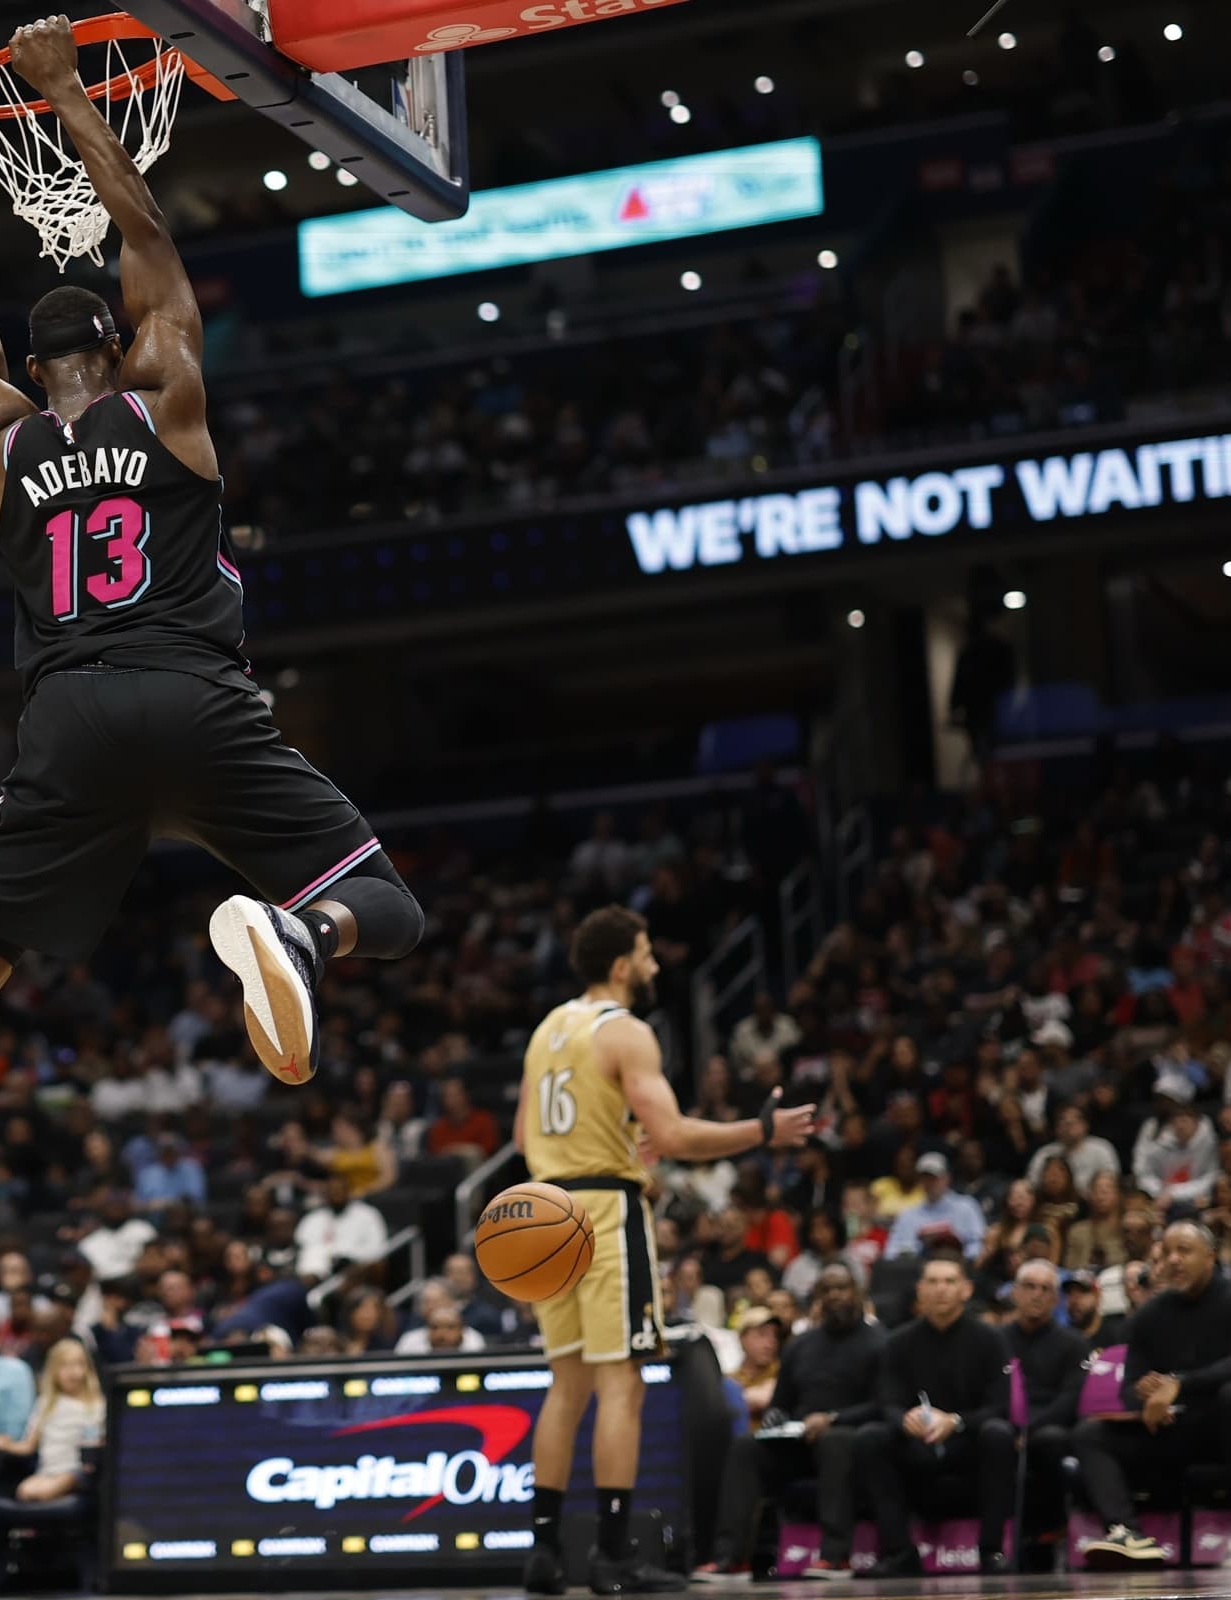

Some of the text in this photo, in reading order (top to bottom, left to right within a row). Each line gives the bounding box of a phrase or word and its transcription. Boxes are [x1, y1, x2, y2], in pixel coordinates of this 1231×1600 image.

[20, 447, 148, 508] ADEBAYO
[626, 433, 1231, 575] WE'RE NOT WAITI
[45, 496, 151, 622] 13
[538, 1067, 577, 1136] 16
